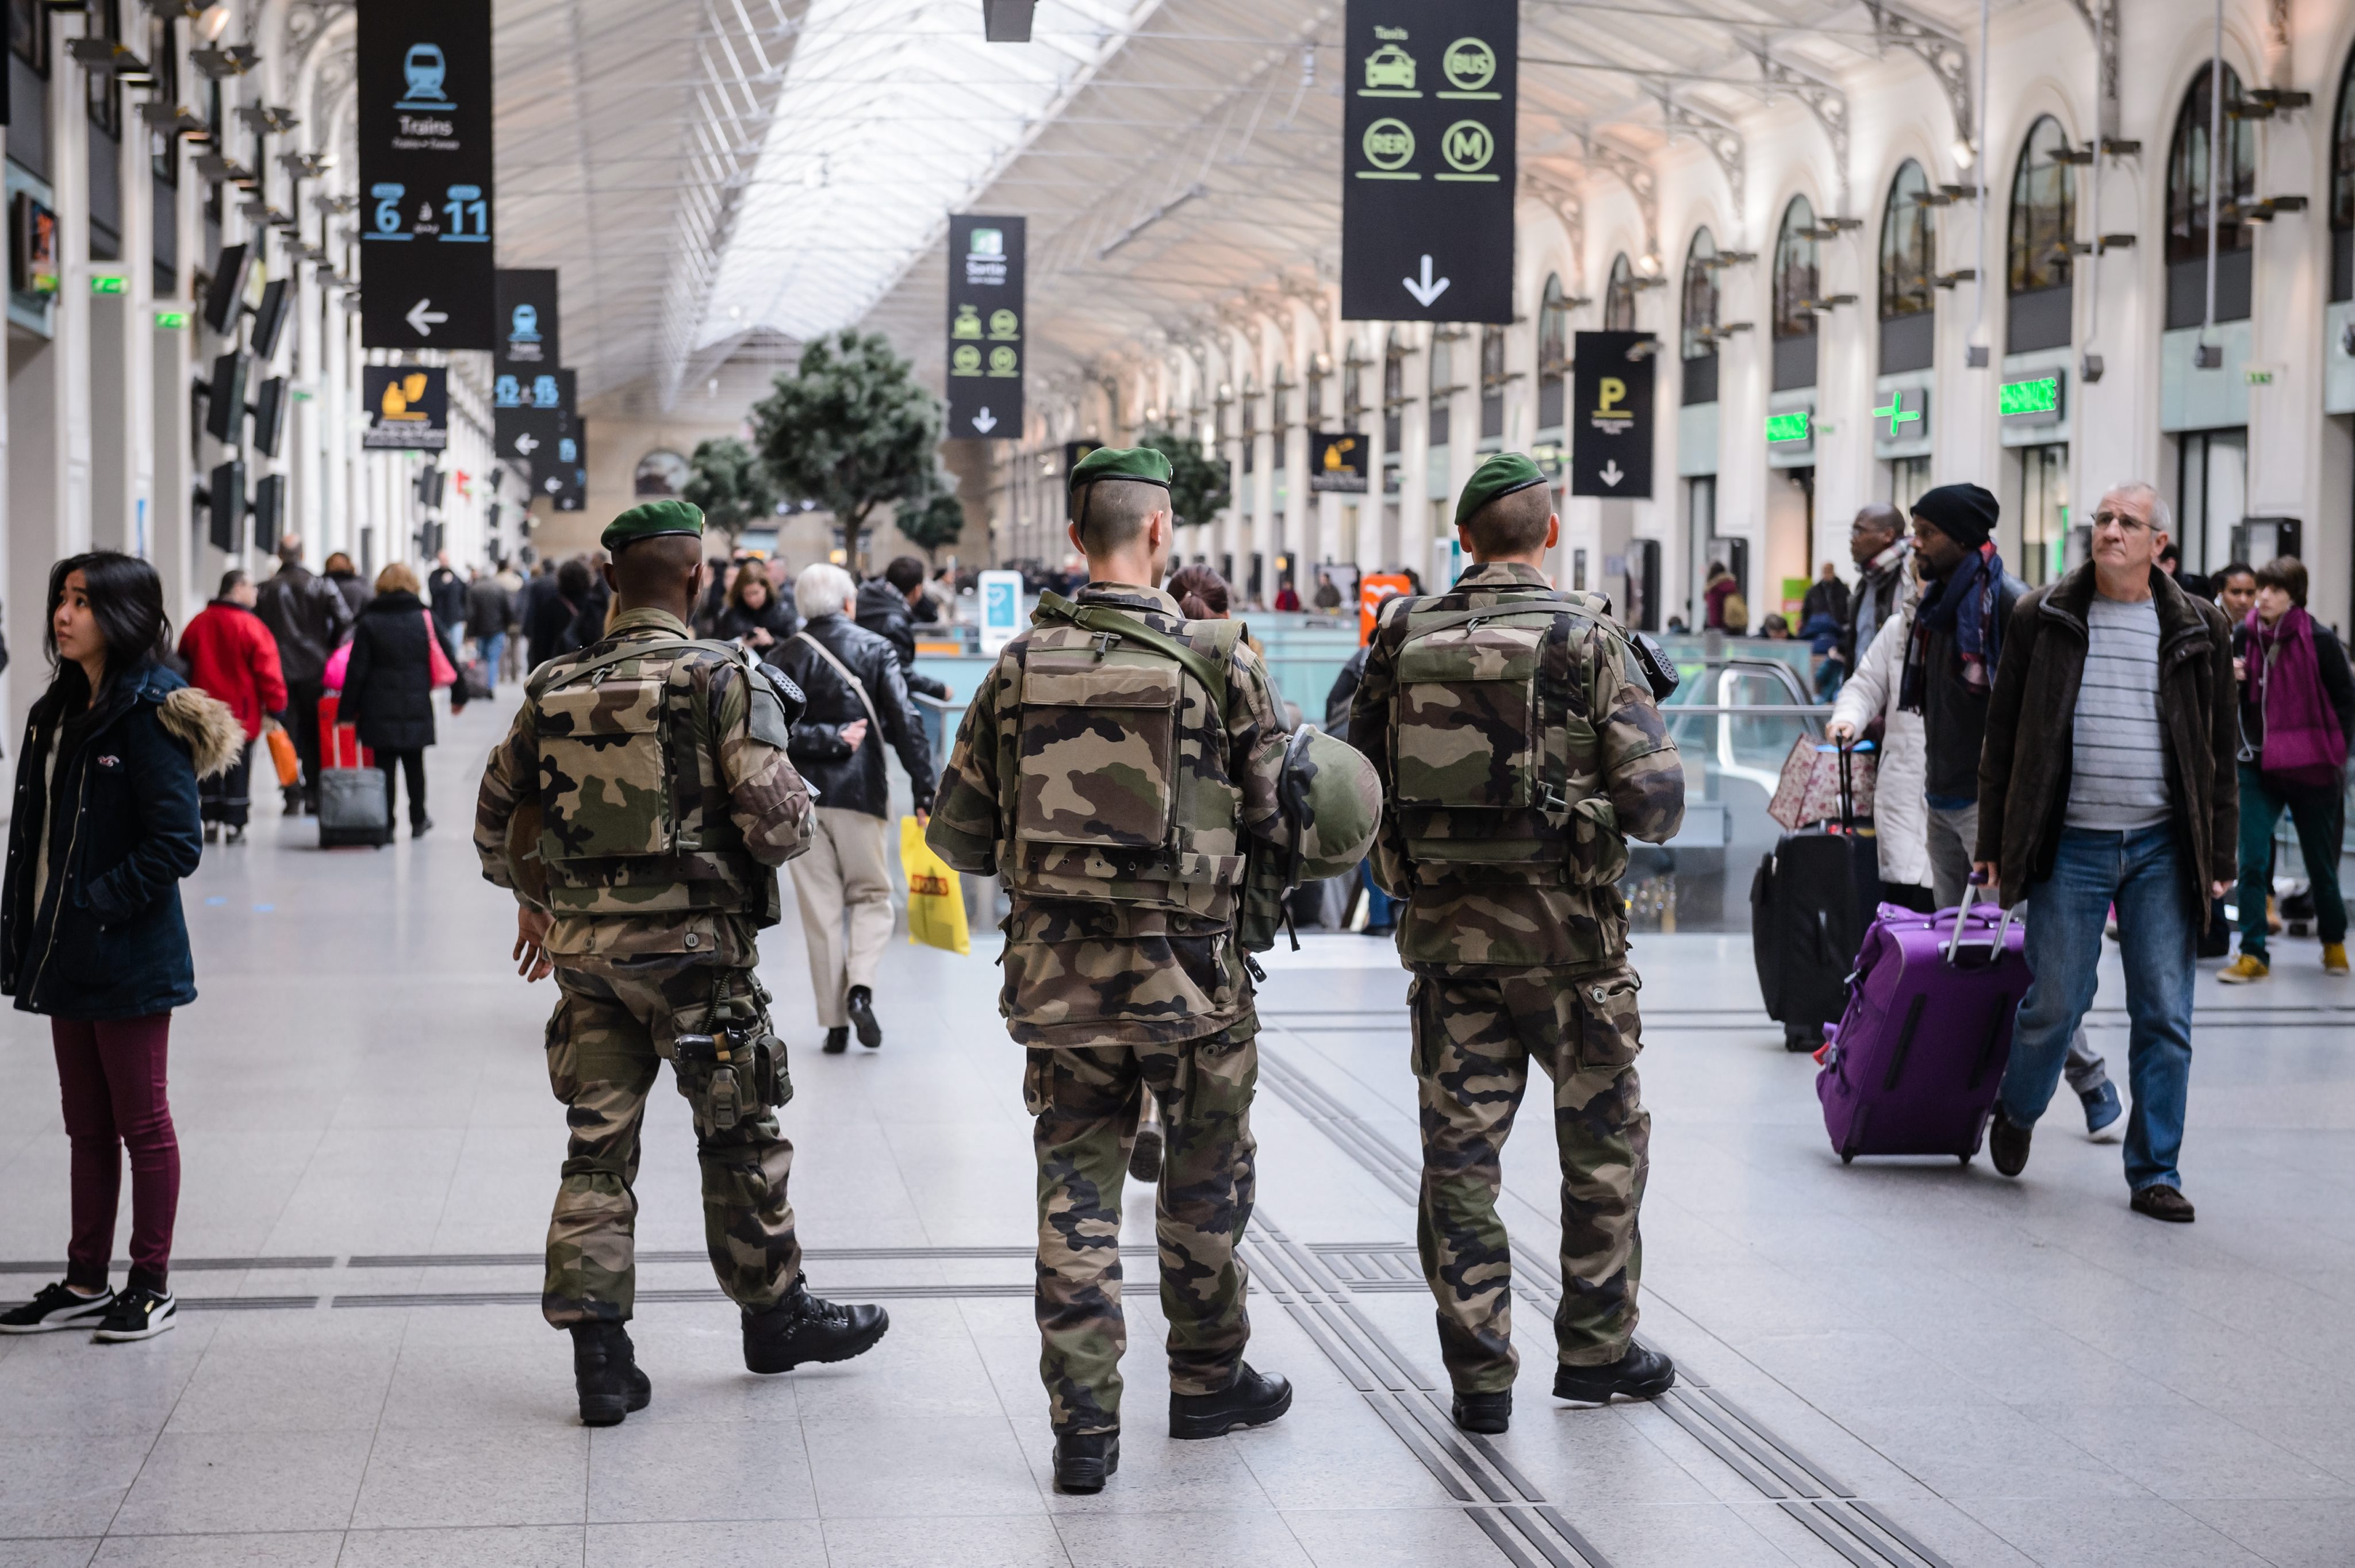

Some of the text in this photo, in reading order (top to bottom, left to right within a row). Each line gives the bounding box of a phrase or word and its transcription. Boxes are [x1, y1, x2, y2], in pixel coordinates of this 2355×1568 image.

[1451, 52, 1490, 75] BUS
[398, 116, 454, 136] Trains
[1453, 130, 1482, 161] M
[374, 199, 401, 233] 6
[442, 199, 488, 235] 11
[1599, 376, 1627, 410] P
